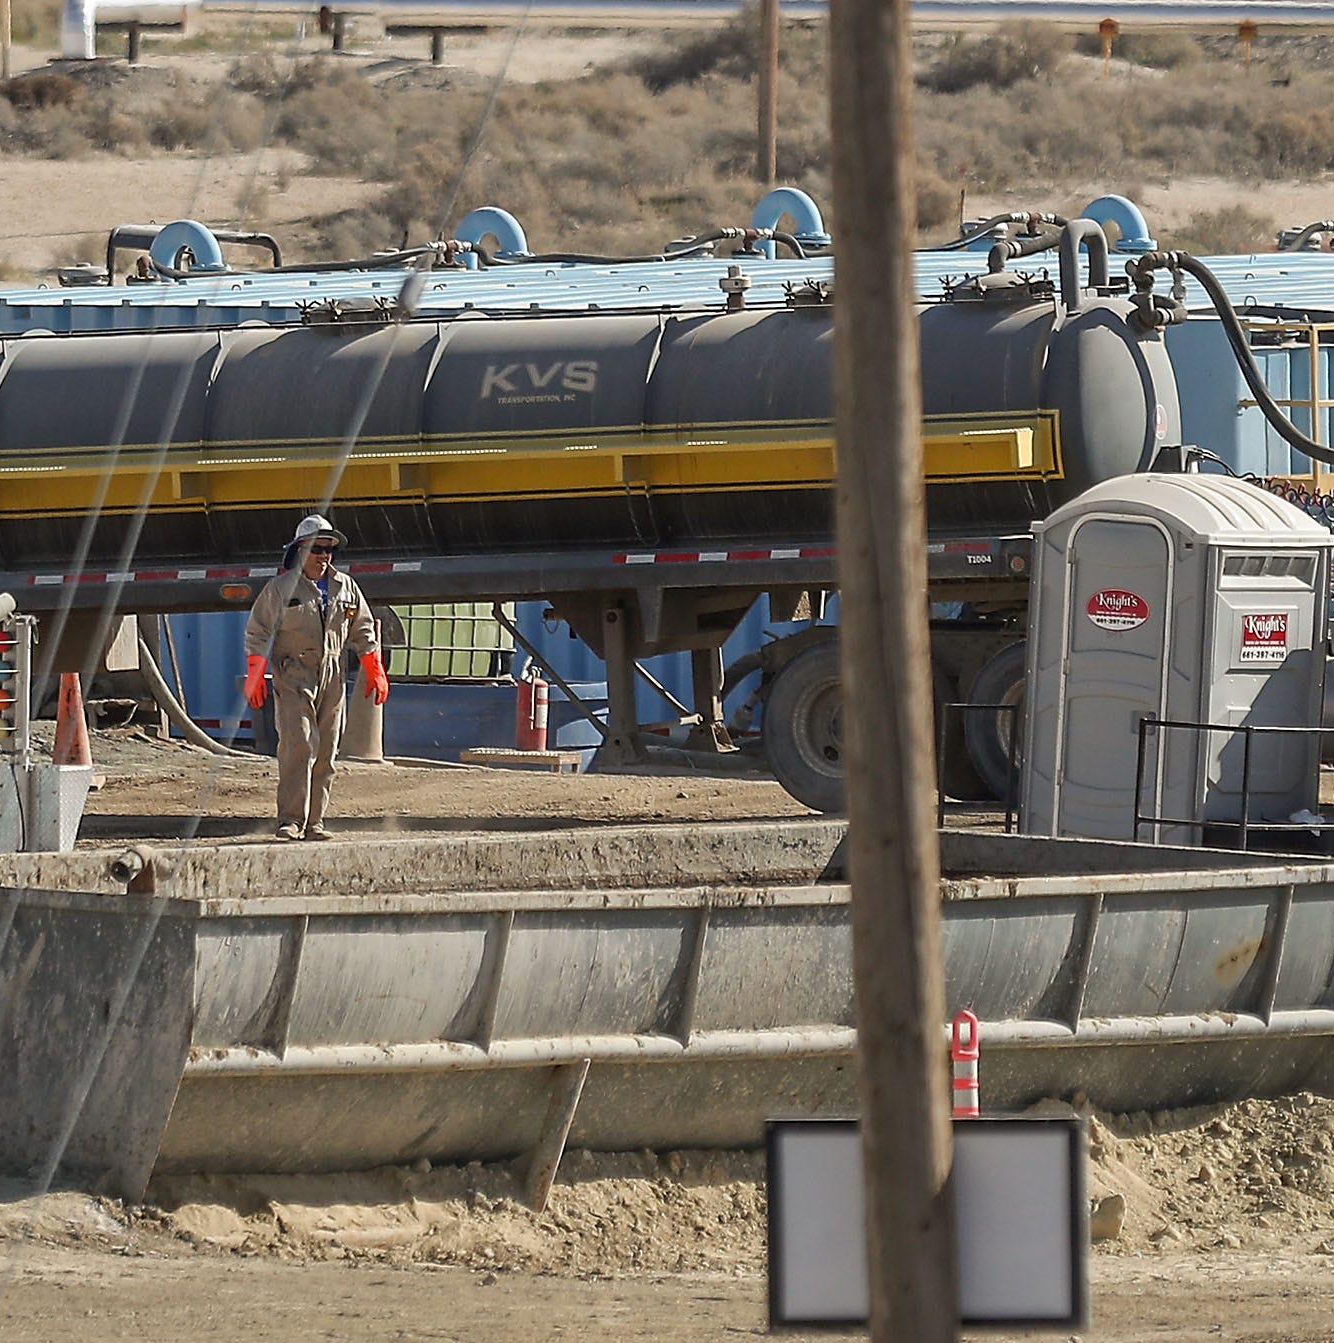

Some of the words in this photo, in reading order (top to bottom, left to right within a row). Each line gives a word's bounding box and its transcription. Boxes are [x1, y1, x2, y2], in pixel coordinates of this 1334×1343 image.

[481, 360, 598, 399] KVS
[1096, 593, 1138, 611] Knight's
[1245, 615, 1286, 640] Knight's
